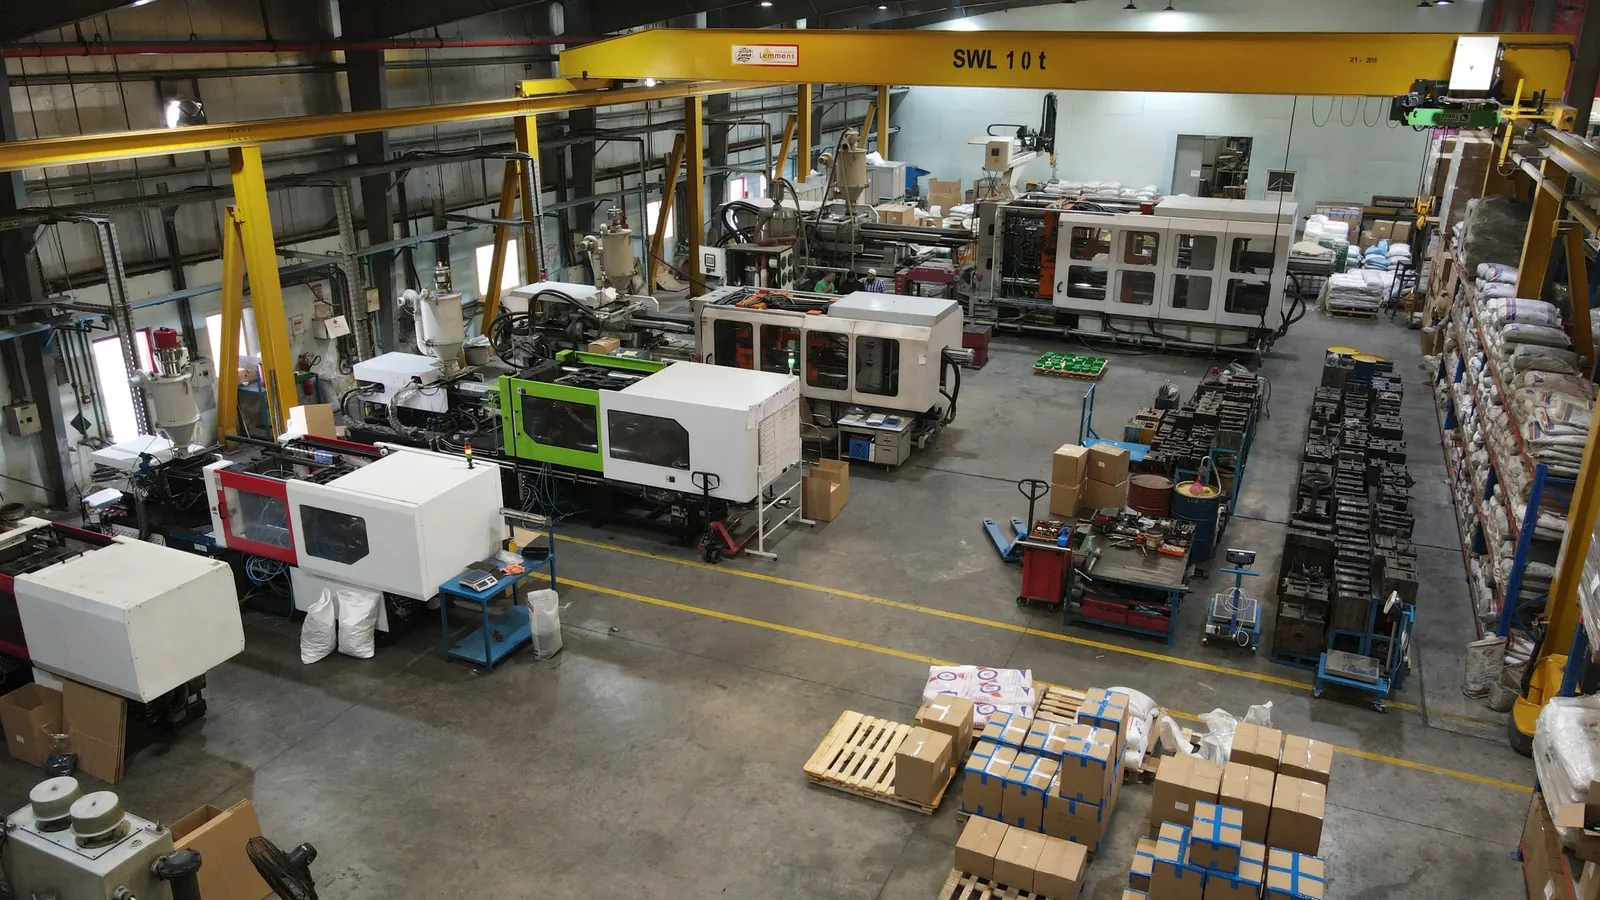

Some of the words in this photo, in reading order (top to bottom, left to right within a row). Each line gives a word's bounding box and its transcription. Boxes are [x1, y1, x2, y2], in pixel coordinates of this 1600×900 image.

[759, 52, 795, 60] Lemmens
[953, 49, 997, 69] SWL
[1039, 51, 1046, 70] t
